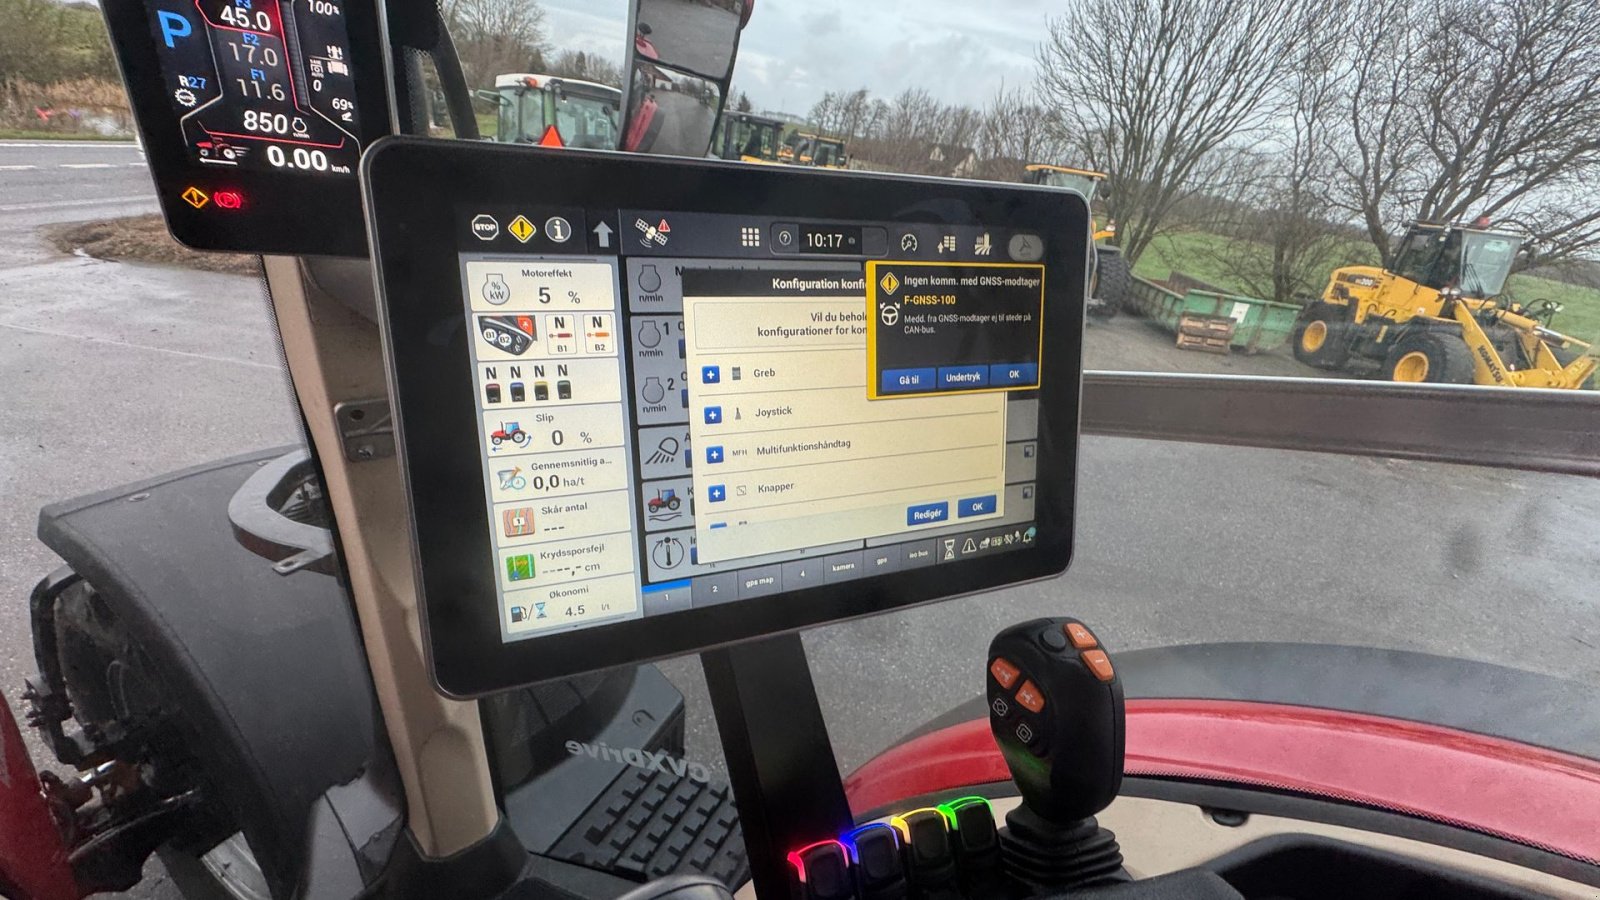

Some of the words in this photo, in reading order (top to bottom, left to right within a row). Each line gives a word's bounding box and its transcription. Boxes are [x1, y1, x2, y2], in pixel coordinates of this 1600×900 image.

[308, 0, 340, 15] 100%
[220, 5, 271, 31] 45.0
[158, 10, 192, 48] P
[243, 32, 259, 46] F2
[228, 42, 278, 67] 17.0
[251, 68, 266, 81] F1
[178, 75, 206, 89] R27
[313, 79, 322, 92] 0
[236, 78, 285, 101] 11.6
[331, 98, 354, 110] 69%
[243, 110, 288, 134] 850
[266, 145, 327, 171] 0.00
[331, 164, 351, 174] km/h
[474, 223, 496, 232] STOP
[807, 233, 843, 248] 10:17
[521, 269, 573, 278] Motoreffekt
[772, 278, 839, 292] Konfiguration
[904, 275, 928, 287] Ingen
[930, 276, 958, 286] komm.
[960, 276, 978, 286] med
[980, 276, 1040, 288] GNSS-modtager
[489, 291, 505, 300] kW
[539, 287, 551, 304] 5
[568, 291, 581, 304] %
[639, 293, 664, 302] n/min
[904, 295, 956, 305] F-GNSS-100
[555, 317, 565, 329] N
[592, 316, 602, 328] N
[811, 312, 823, 322] Vil
[825, 312, 838, 322] du
[904, 315, 926, 323] Medd.
[927, 314, 937, 323] fra
[938, 314, 991, 324] GNSS-modtager
[663, 322, 669, 336] 1
[757, 327, 833, 339] konfigurationer
[835, 325, 849, 335] for
[904, 326, 936, 334] CAN-bus.
[499, 336, 510, 344] B2
[557, 345, 568, 353] B1
[595, 344, 606, 352] B2
[639, 349, 664, 357] n/min
[1477, 345, 1504, 383] KOMATSU
[486, 366, 497, 380] N
[510, 366, 521, 379] N
[534, 365, 545, 378] N
[557, 364, 568, 377] N
[753, 368, 776, 378] Greb
[1009, 370, 1020, 379] OK
[899, 376, 910, 385] Gå
[911, 375, 919, 384] til
[946, 372, 981, 383] Undertryk
[667, 378, 675, 391] 2
[642, 404, 667, 413] n/min
[755, 406, 793, 418] Joystick
[535, 414, 554, 424] Slip
[552, 430, 564, 446] 0
[580, 431, 592, 444] %
[756, 439, 851, 456] Multifunktionshåndtag
[531, 458, 598, 471] Gennemsnitlig
[533, 474, 560, 492] 0,0
[563, 477, 585, 488] ha/t
[758, 482, 795, 493] Knapper
[541, 505, 563, 515] Skår
[565, 503, 588, 512] antal
[972, 503, 983, 511] OK
[914, 509, 942, 521] Redigér
[540, 543, 605, 561] Krydssporsfejl
[918, 550, 928, 558] bus
[832, 562, 855, 572] kamera
[876, 557, 887, 566] gps
[584, 564, 601, 572] cm
[746, 579, 758, 589] gps
[759, 577, 774, 585] map
[549, 585, 589, 599] Økonomi
[565, 605, 585, 617] 4.5
